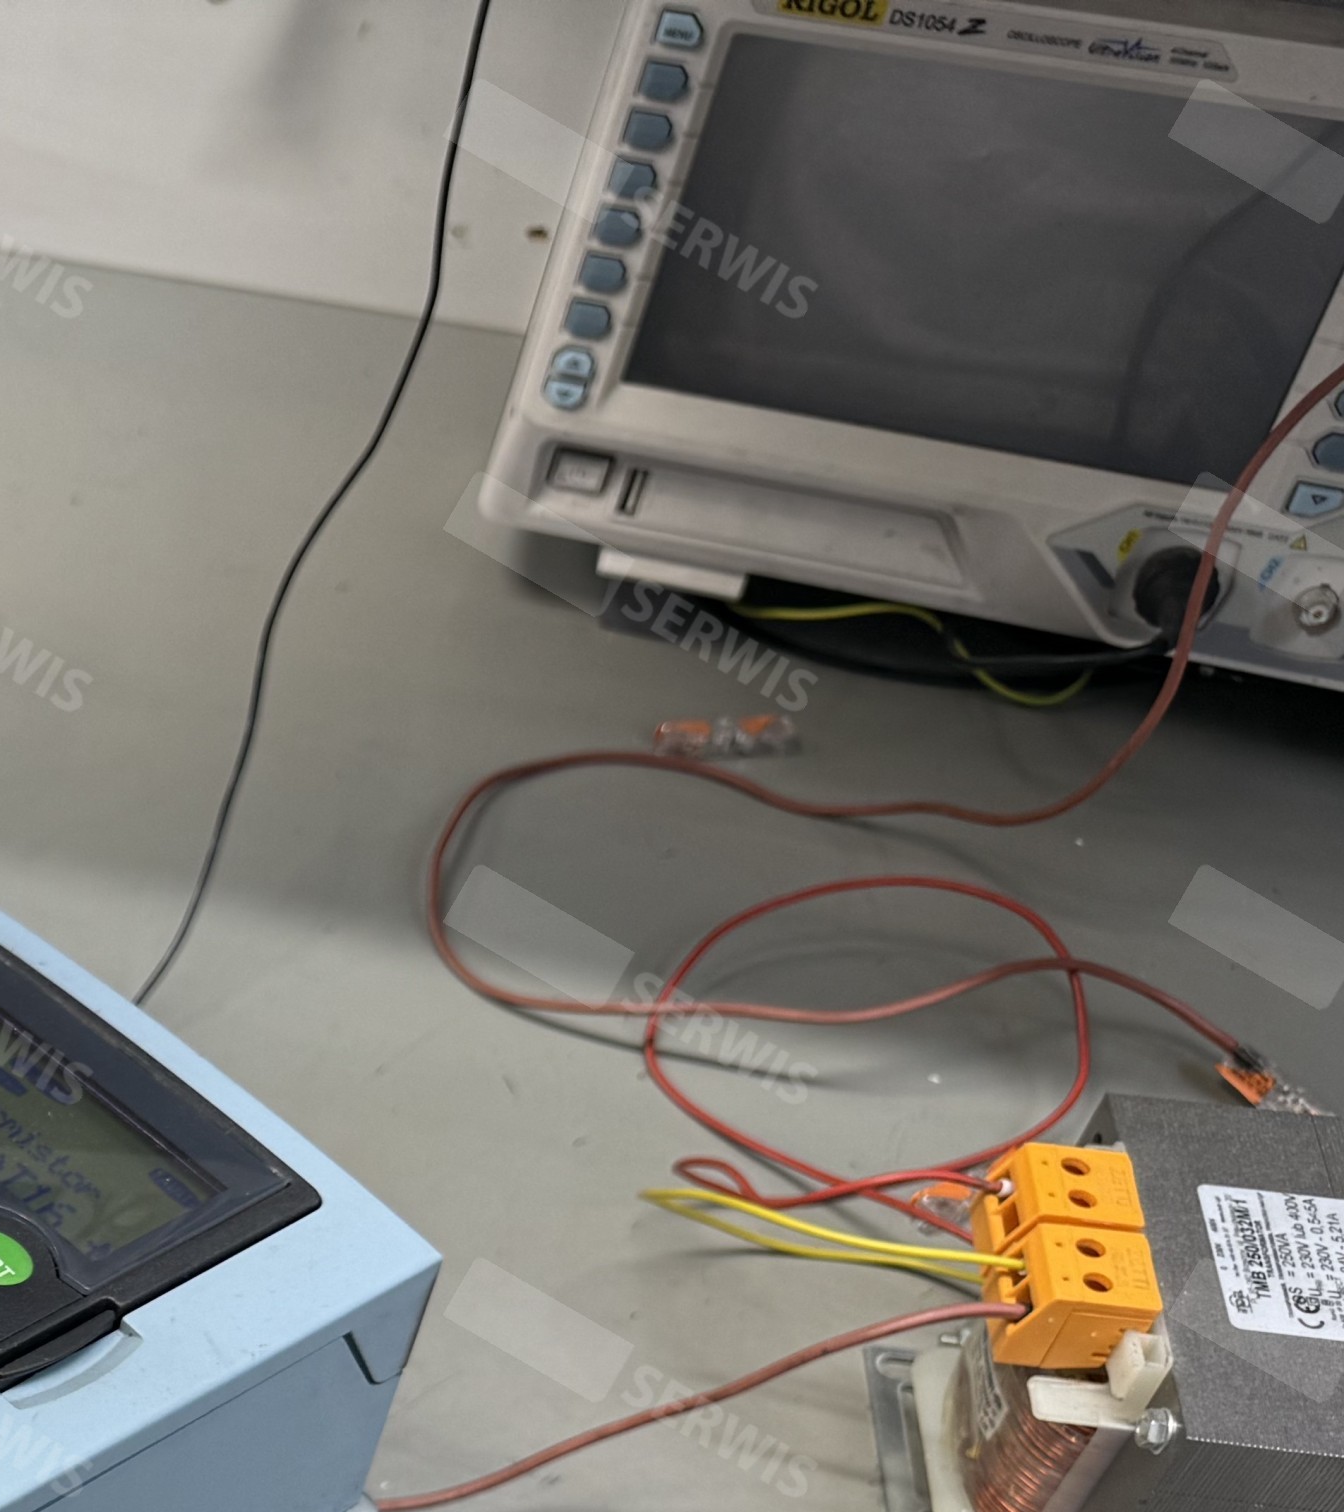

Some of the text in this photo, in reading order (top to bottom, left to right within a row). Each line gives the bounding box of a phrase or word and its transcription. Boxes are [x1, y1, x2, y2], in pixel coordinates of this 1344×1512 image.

[1275, 1232, 1297, 1268] 250VA
[1296, 1240, 1316, 1269] 230V
[1315, 1242, 1335, 1272] 230V
[1250, 1270, 1272, 1299] TMB
